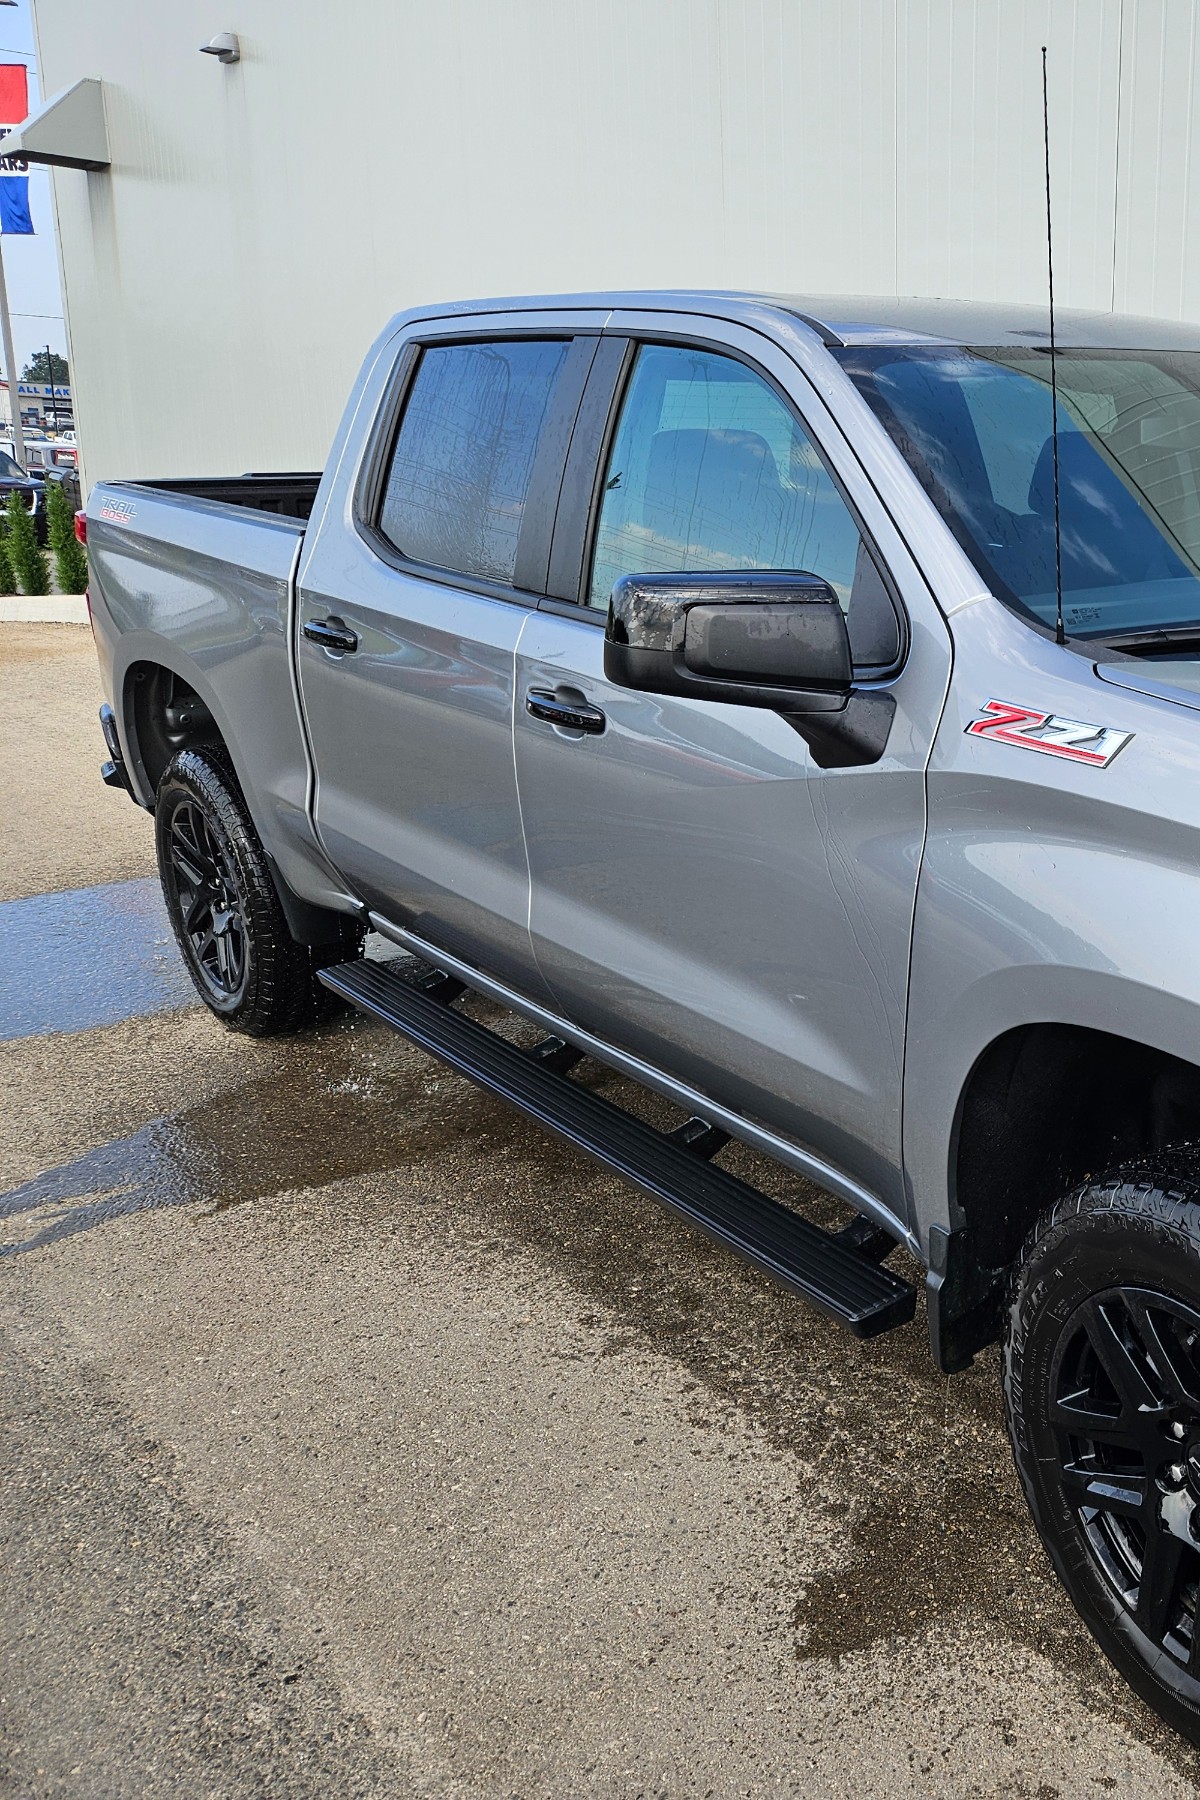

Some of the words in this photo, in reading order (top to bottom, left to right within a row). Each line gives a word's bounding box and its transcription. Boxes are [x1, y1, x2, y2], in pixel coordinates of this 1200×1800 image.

[18, 386, 40, 394] ALL
[100, 507, 130, 525] BOSS
[101, 495, 138, 518] TRAIL
[963, 697, 1136, 769] Z71
